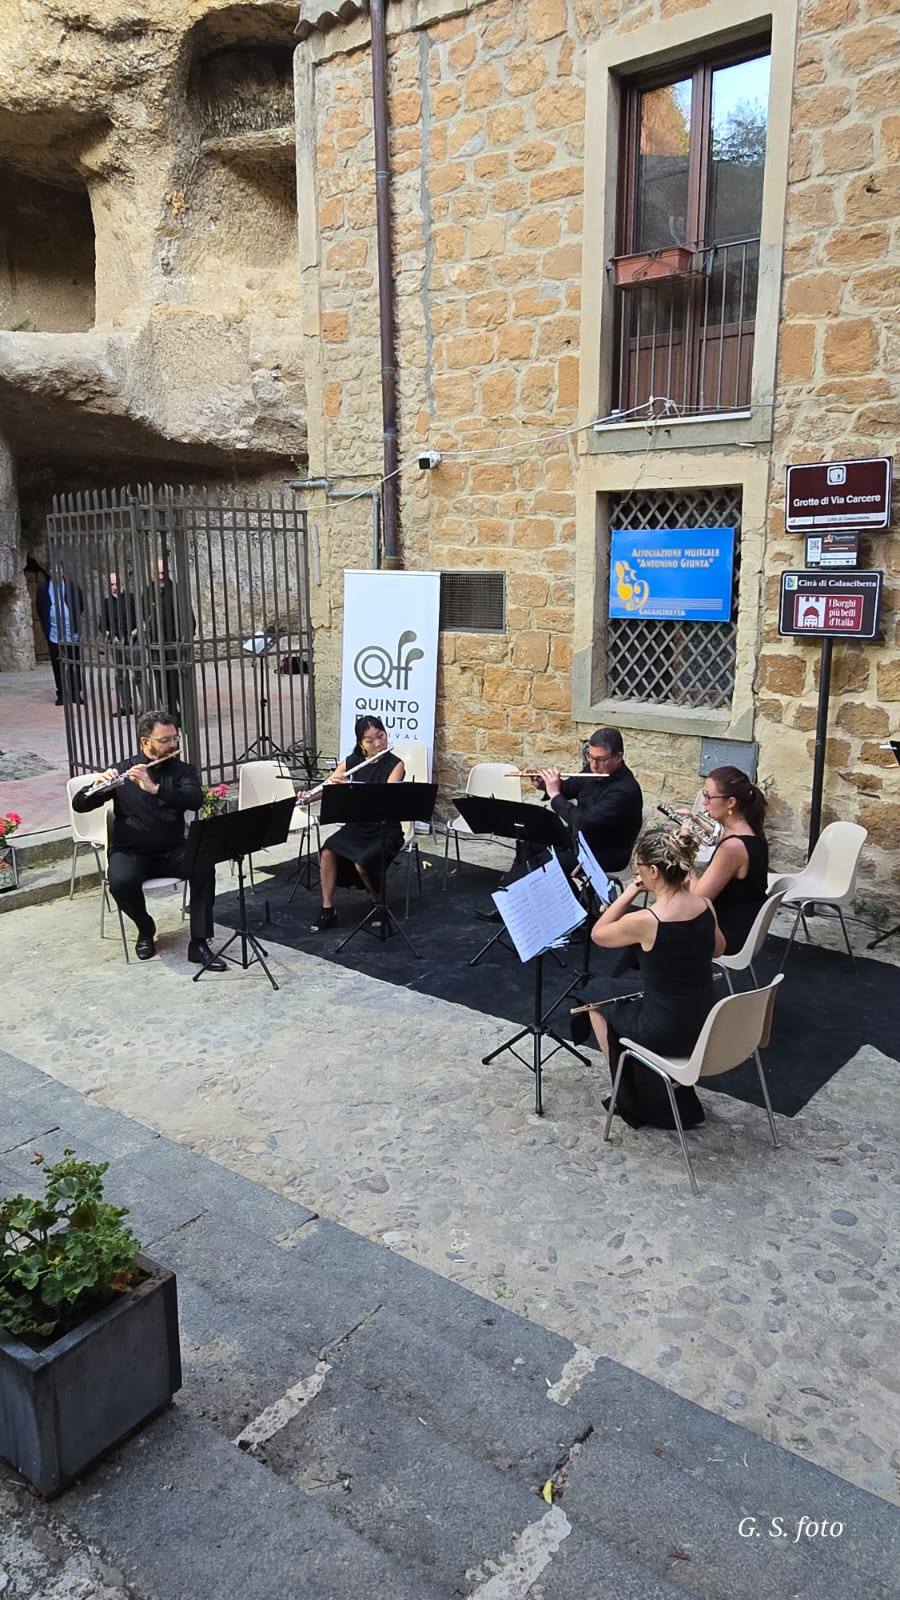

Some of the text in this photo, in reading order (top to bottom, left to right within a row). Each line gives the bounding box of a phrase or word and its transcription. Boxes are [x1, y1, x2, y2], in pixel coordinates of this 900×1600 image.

[793, 494, 881, 507] Grotte di Via Carcere
[799, 579, 877, 588] Città di Calascibetta
[832, 598, 856, 609] Borghi
[842, 608, 856, 617] belli
[355, 697, 420, 714] QUINTO
